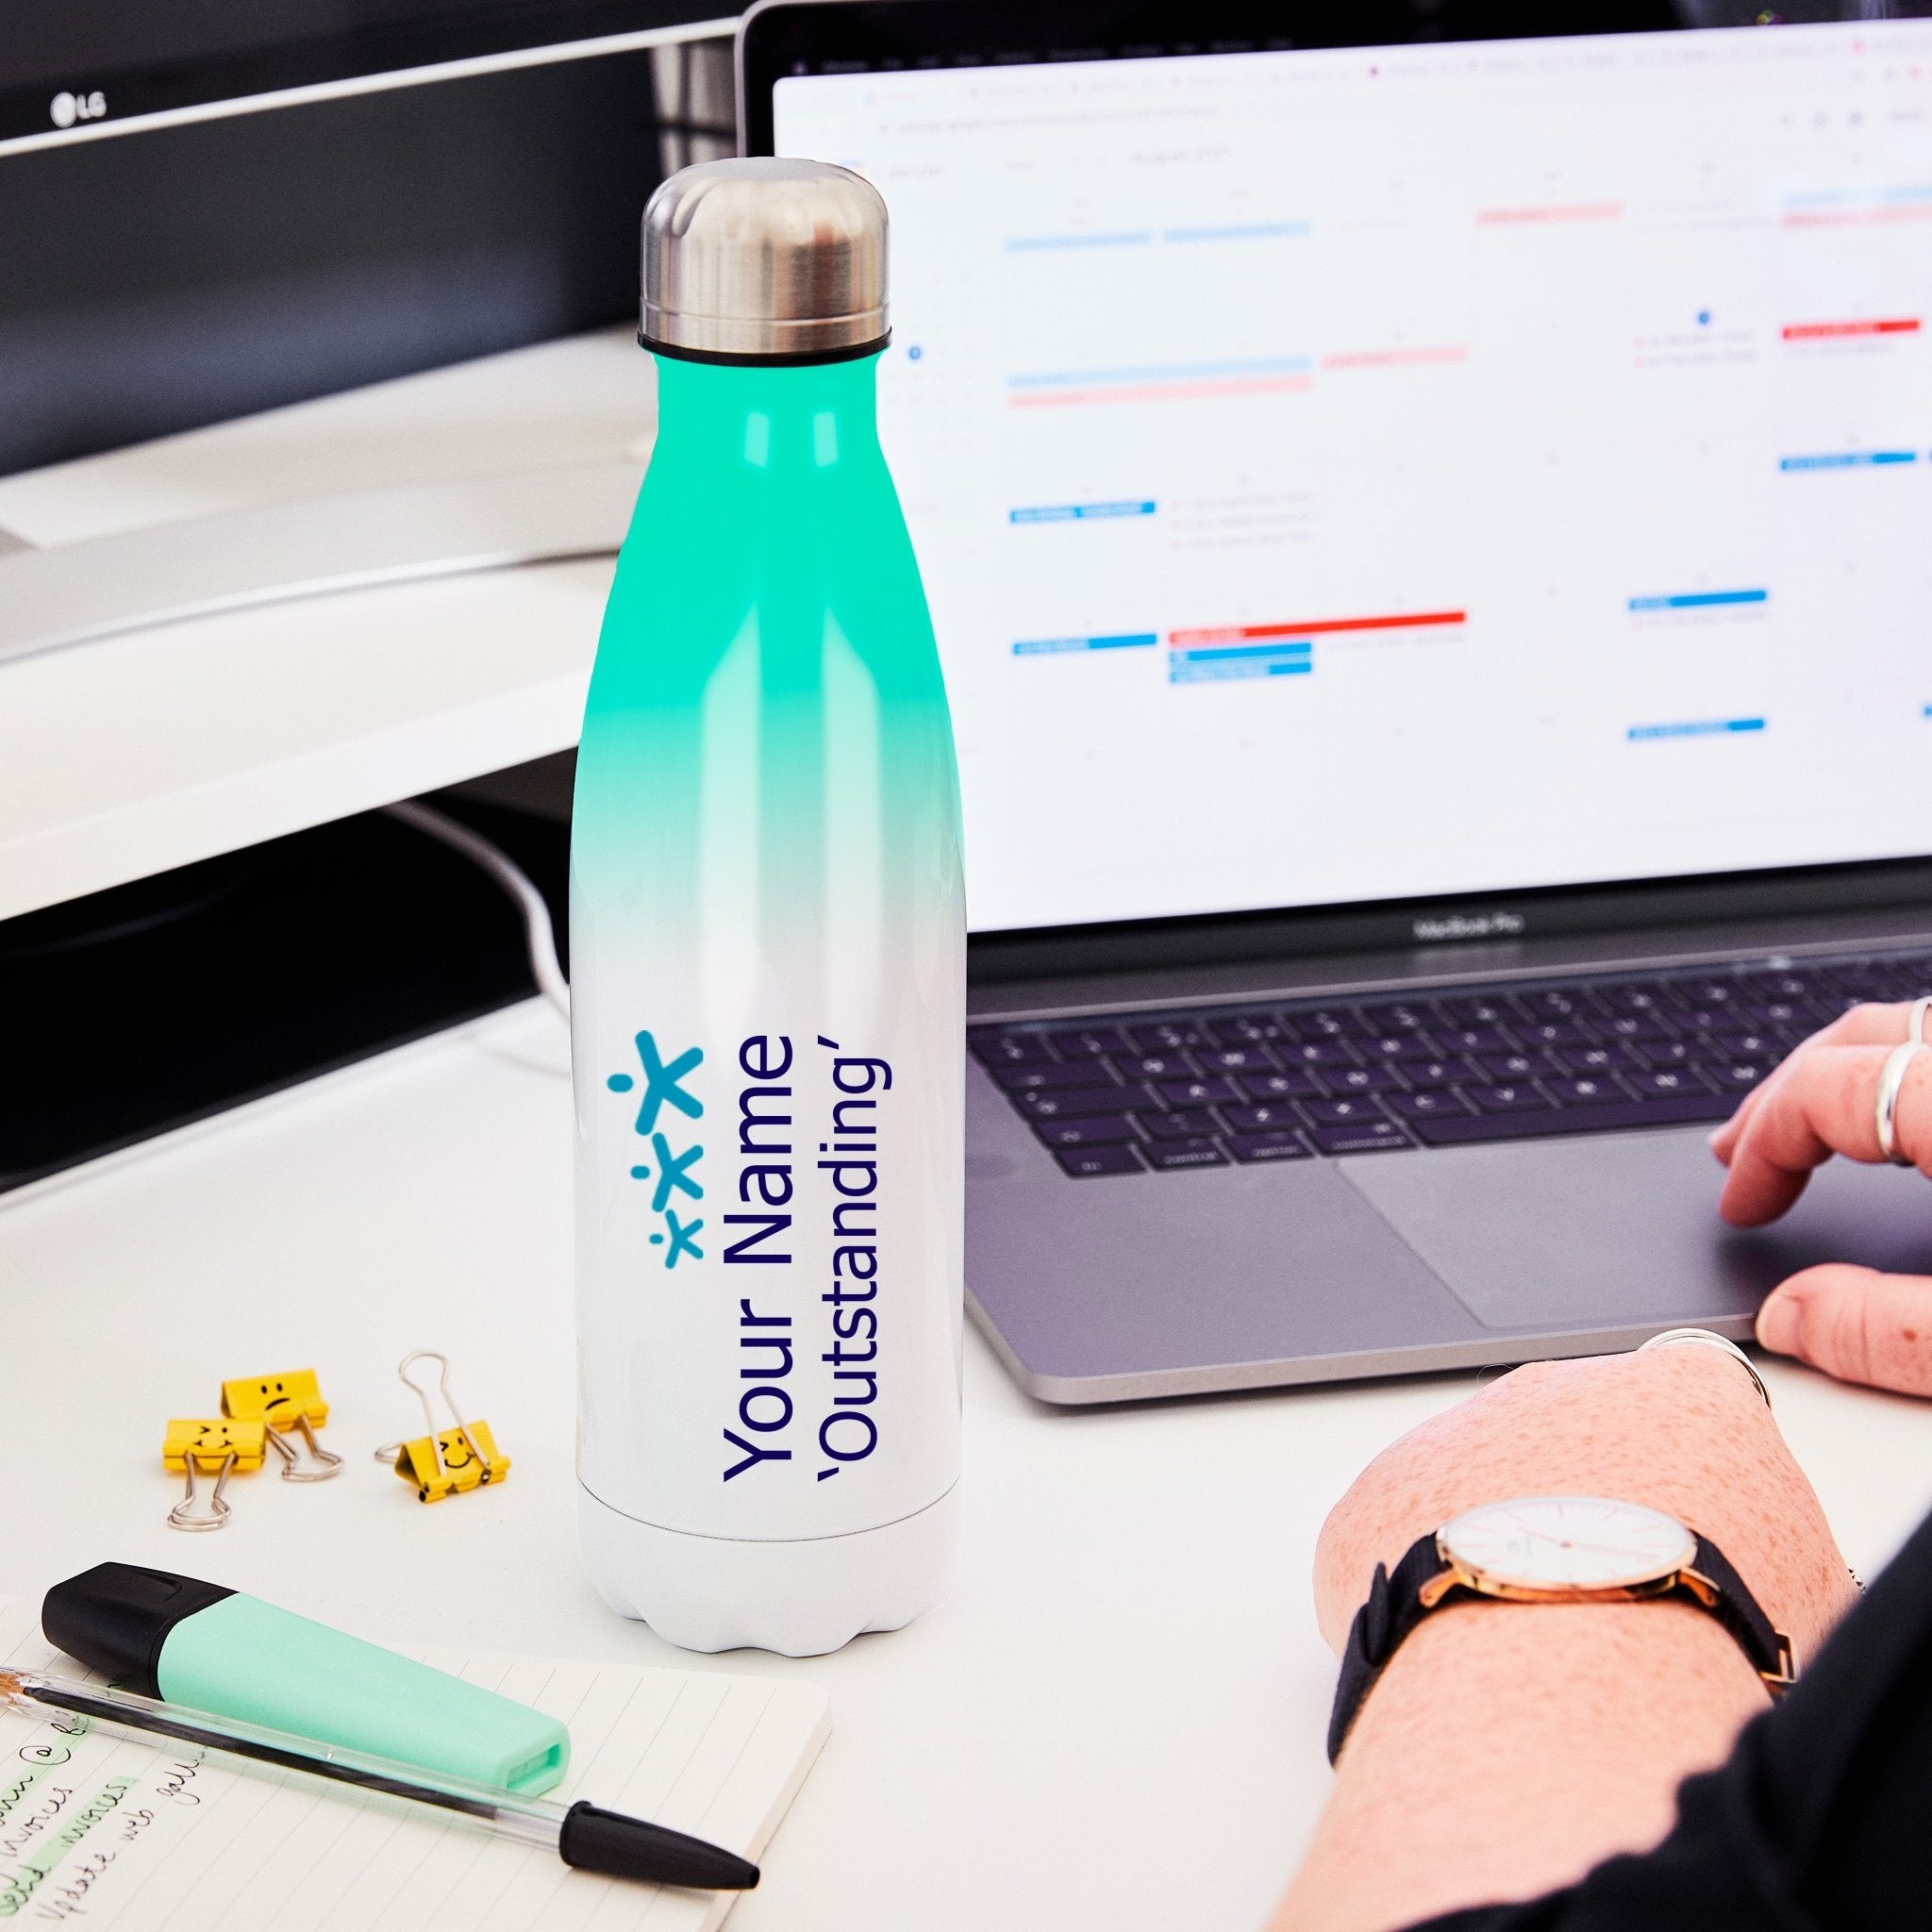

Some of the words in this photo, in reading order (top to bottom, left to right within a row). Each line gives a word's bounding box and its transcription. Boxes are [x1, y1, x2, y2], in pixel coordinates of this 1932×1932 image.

[76, 91, 107, 120] LG
[724, 1036, 792, 1263] Name
[724, 1299, 792, 1482] Your
